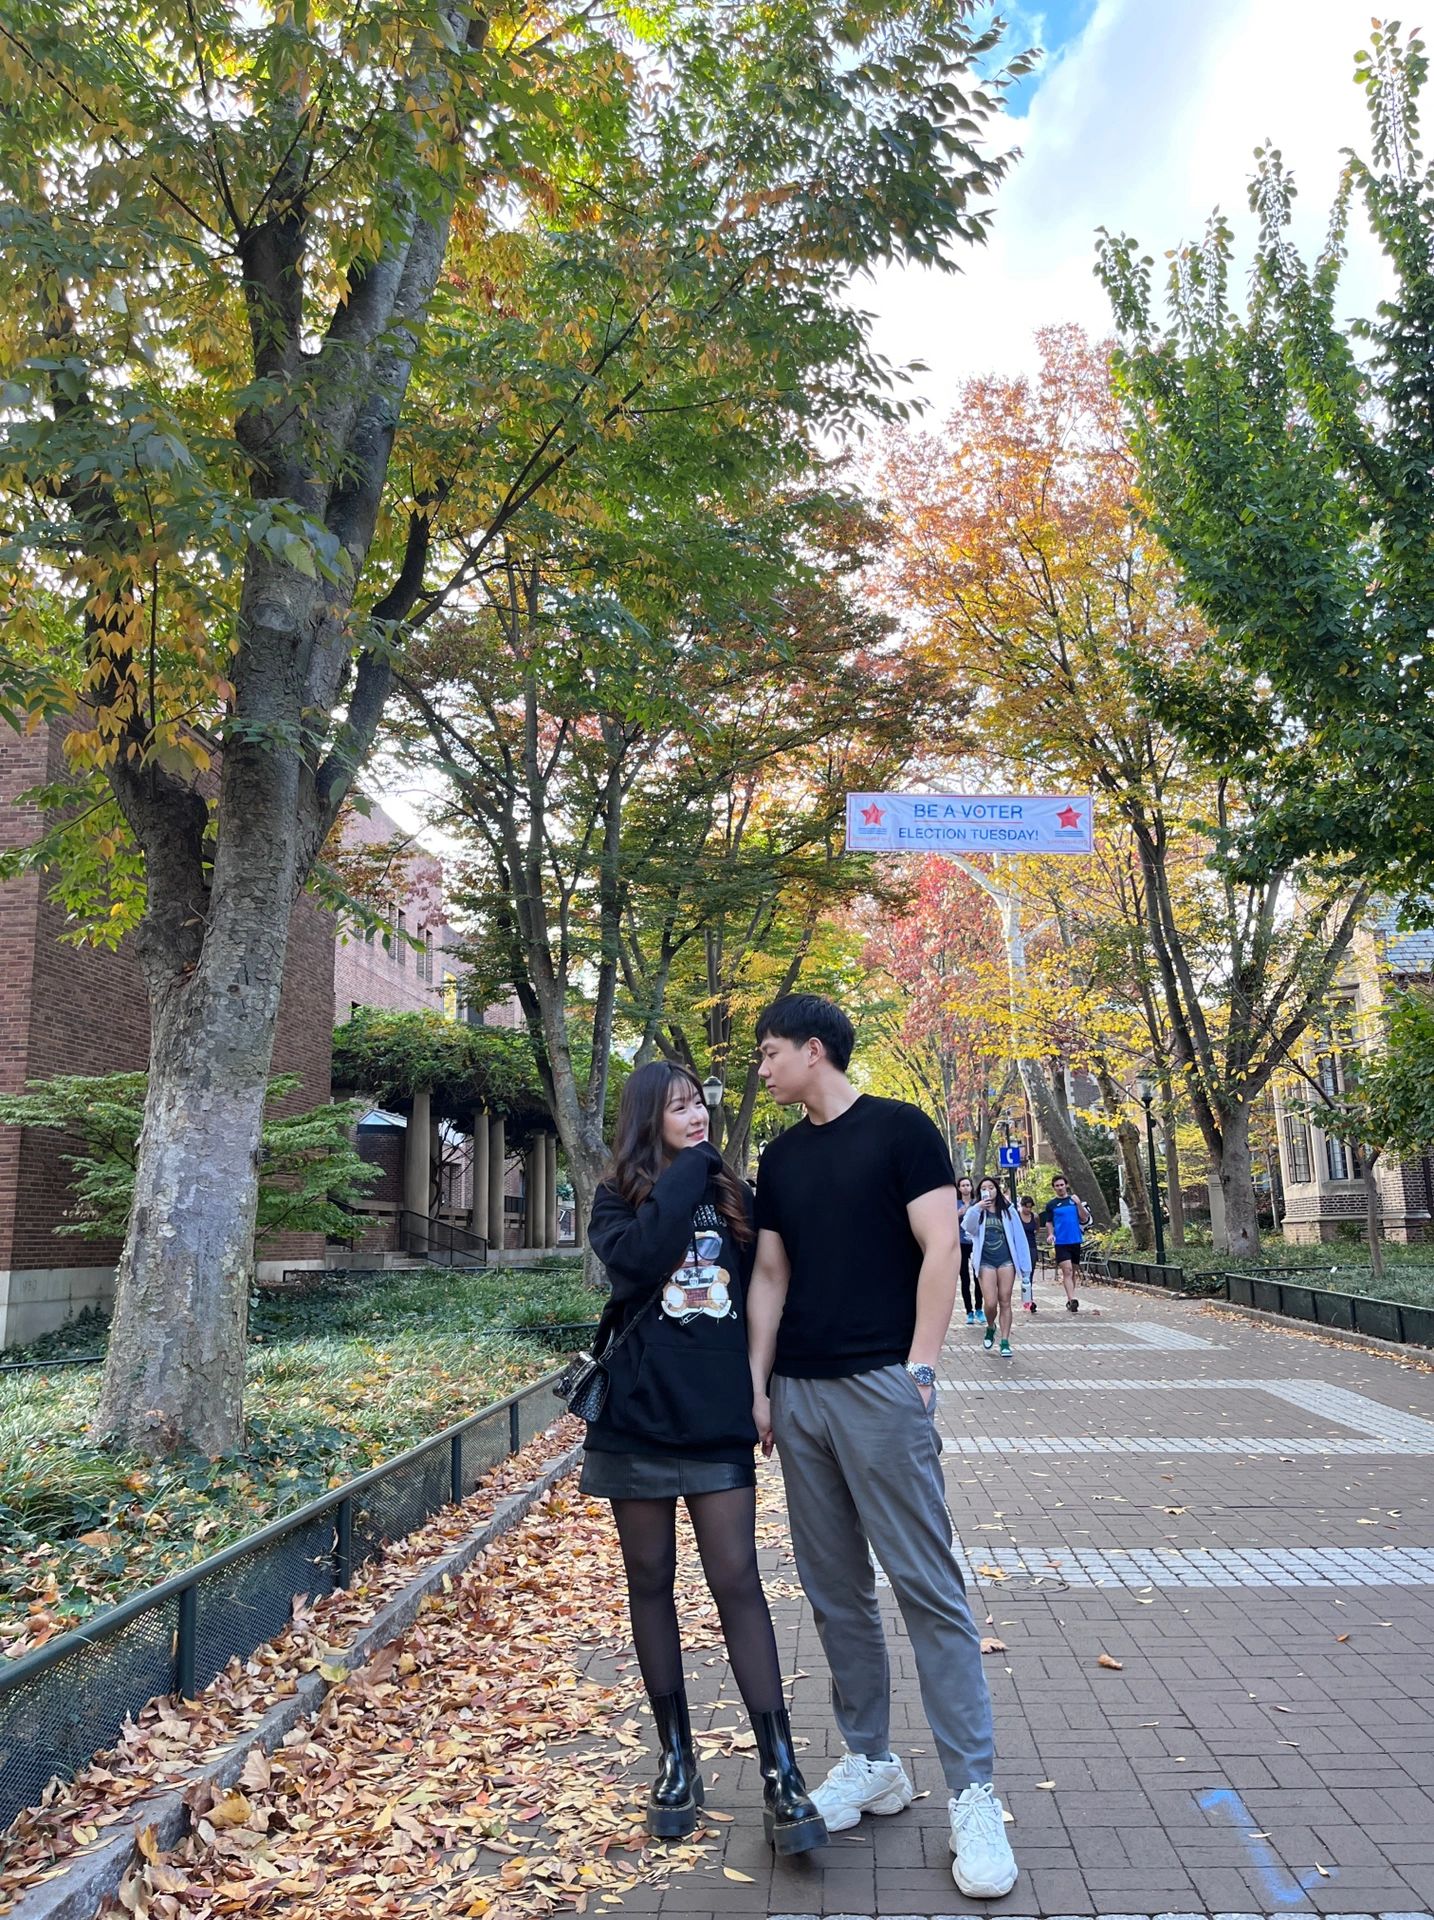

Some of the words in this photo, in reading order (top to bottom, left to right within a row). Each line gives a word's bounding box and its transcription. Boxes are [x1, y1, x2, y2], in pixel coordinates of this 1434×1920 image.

[914, 803, 939, 818] BE
[943, 804, 957, 818] A
[963, 804, 1023, 819] VOTER
[898, 827, 966, 840] ELECTION
[970, 829, 1039, 841] TUESDAY!
